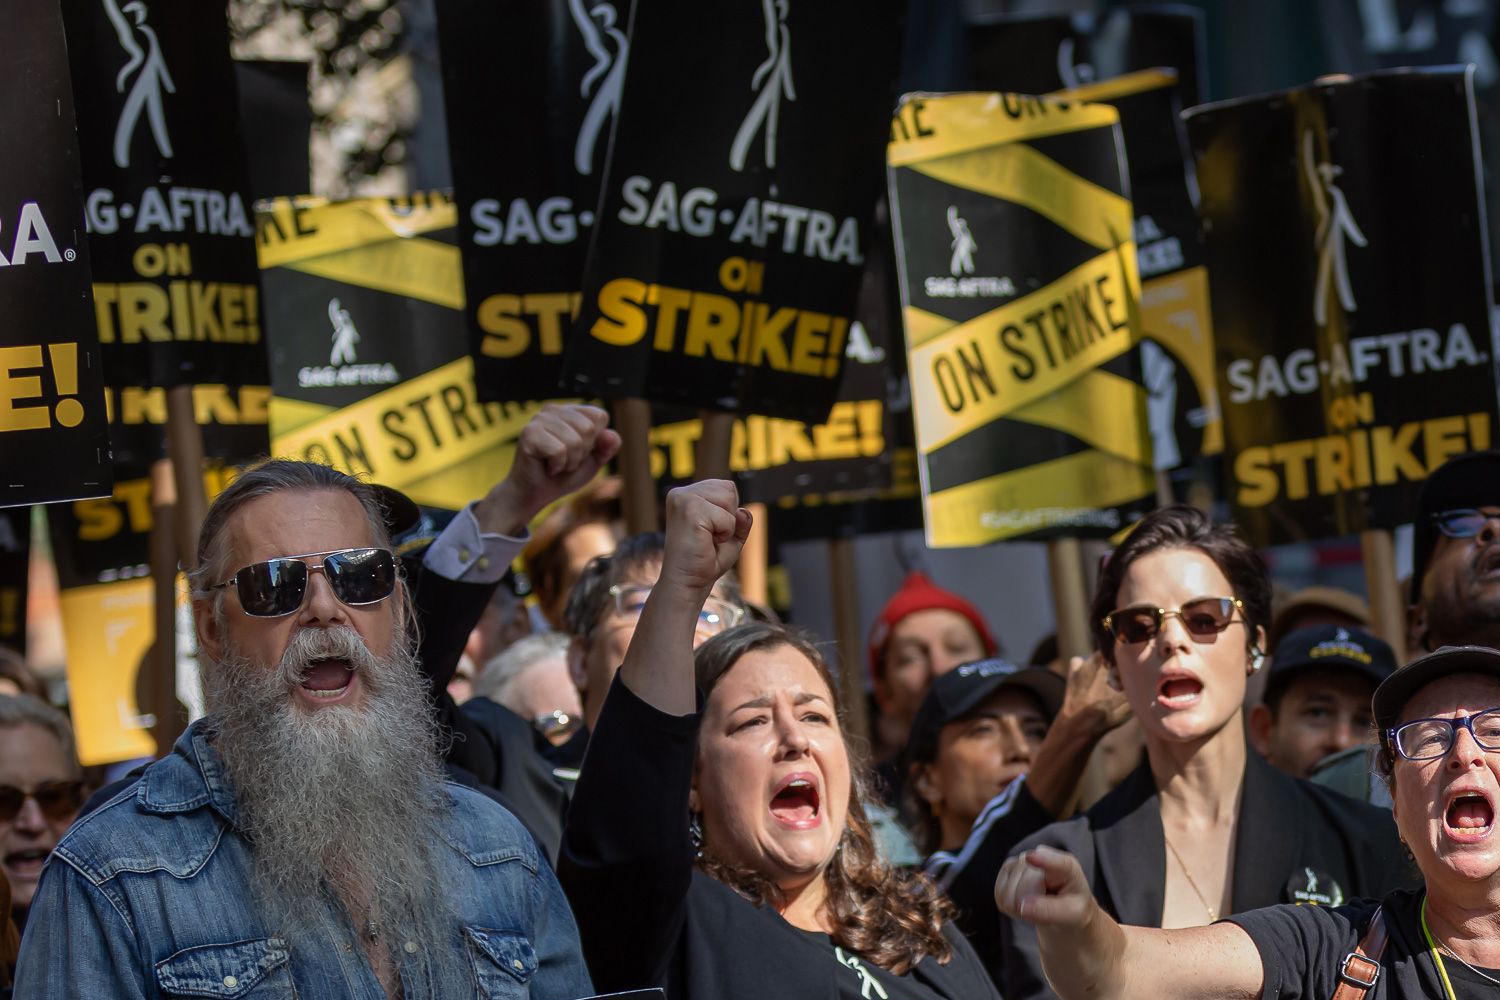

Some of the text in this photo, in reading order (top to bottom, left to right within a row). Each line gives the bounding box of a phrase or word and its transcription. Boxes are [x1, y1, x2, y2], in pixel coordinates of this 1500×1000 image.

[133, 242, 193, 279] ON
[589, 276, 849, 381] STRIKE!
[930, 275, 1129, 415] ON STRIKE
[1327, 391, 1376, 429] ON
[1233, 412, 1493, 508] STRIKE!
